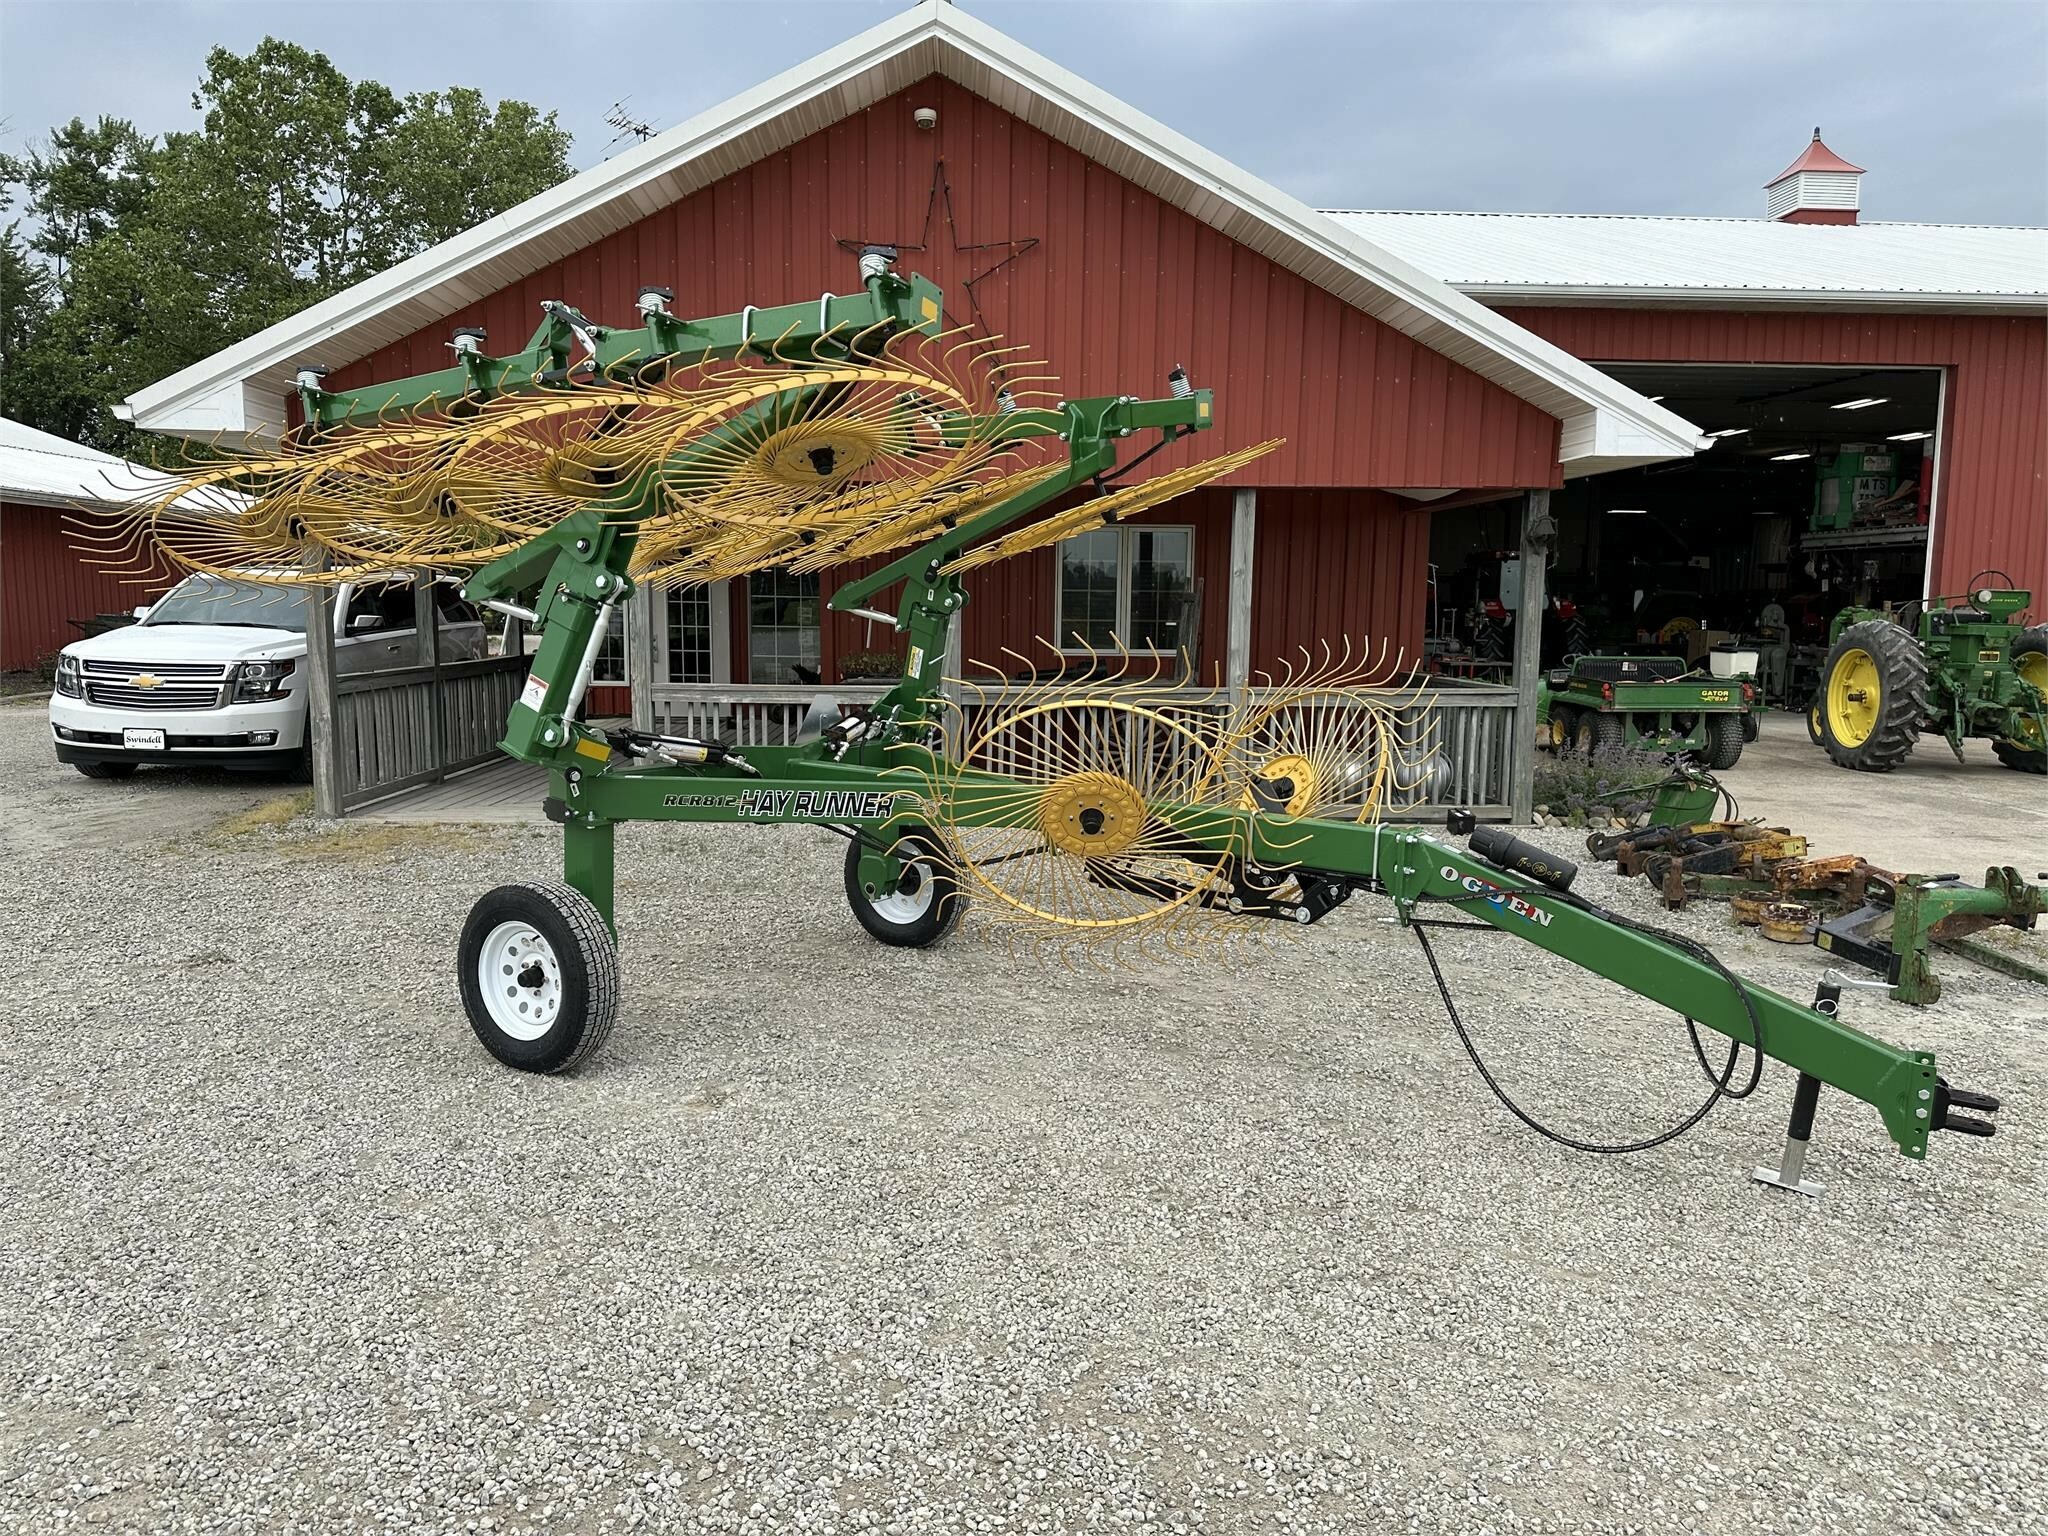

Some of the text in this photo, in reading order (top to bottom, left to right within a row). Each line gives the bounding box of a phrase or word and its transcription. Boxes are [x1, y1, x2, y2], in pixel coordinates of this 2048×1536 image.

[663, 790, 896, 818] RCR812 HAY RUNNER
[1440, 865, 1555, 927] OGDEN
